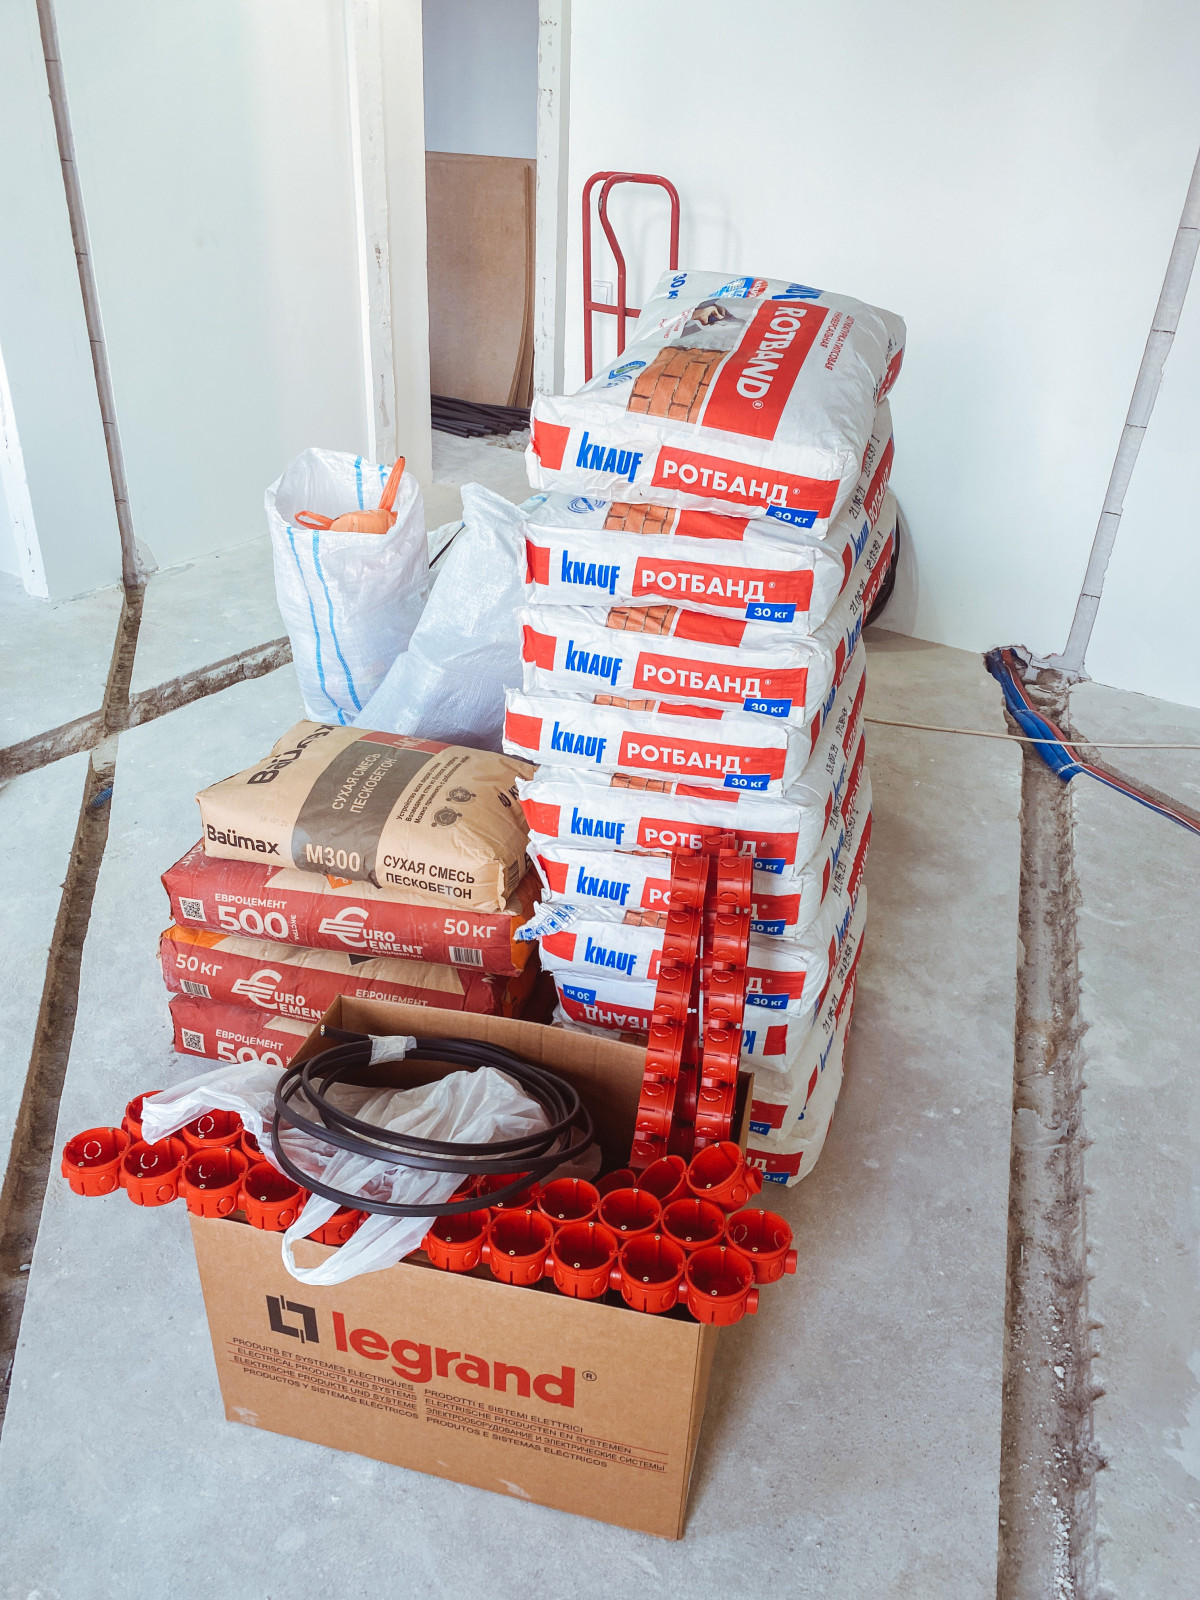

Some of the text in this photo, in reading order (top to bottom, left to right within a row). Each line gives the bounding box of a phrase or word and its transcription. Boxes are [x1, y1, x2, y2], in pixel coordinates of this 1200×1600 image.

[735, 306, 807, 399] ROTBAND
[576, 431, 643, 483] KNAUF
[662, 459, 788, 508] РОТБАНД
[774, 511, 808, 524] 30 кг
[561, 550, 620, 595] KNAUF
[641, 569, 766, 603] РОТБАНД
[754, 607, 788, 619] 30 кг
[565, 640, 622, 686] KNAUF
[643, 664, 762, 699] РОТБАНД
[751, 703, 785, 715] 30 кг
[550, 721, 607, 764] KNAUF
[627, 743, 742, 774] РОТБАНД
[332, 753, 381, 810] СУХАЯ СМЕСЬ
[350, 757, 398, 814] ПЕСКОБЕТОН
[731, 777, 764, 789] 30 кг
[206, 824, 280, 856] Baümax
[571, 807, 625, 845] KNAUF
[645, 828, 758, 858] РОТБД
[306, 843, 361, 873] М300
[383, 855, 475, 884] СУХАЯ СМЕСЬ
[214, 893, 288, 910] ЕВРОЦЕМЕНТ
[385, 872, 472, 900] ПЕСКОБЕТОН
[576, 866, 631, 906] KNAUF
[218, 905, 289, 939] 500
[288, 914, 300, 940] ЭКСТРА
[444, 918, 470, 937] 50
[175, 953, 199, 972] 50
[584, 937, 637, 976] KNAUF
[577, 991, 590, 1001] 30
[753, 998, 783, 1007] 30 кг
[583, 1004, 648, 1030] ТБАНД
[216, 1029, 284, 1051] ЕВРОЦЕМЕНТ
[217, 1040, 284, 1069] 500
[232, 1337, 414, 1391] PRODUITS ET SYSTEMES ELECTRIQUES
[237, 1347, 417, 1400] ELECTRICAL PRODUCTS AND SYSTEMS
[332, 1311, 575, 1408] legrand
[234, 1355, 417, 1410] ELEKTRISCHE PRODUKTE UND SYSTEME
[243, 1367, 300, 1387] PRODUCTOS
[311, 1385, 357, 1402] SISTEMAS
[424, 1388, 476, 1407] PRODOTTI
[487, 1404, 528, 1420] SISTEMI
[531, 1415, 583, 1433] ELETTRICI
[425, 1398, 632, 1454] ELEKTRISCHE PRODUCTEN EN SYSTEMEN
[426, 1416, 481, 1436] PRODUTOS
[492, 1433, 541, 1450] SISTEMAS
[426, 1407, 533, 1439] ЭЛЕКТРООБОРУДОВАНИЕ
[544, 1437, 617, 1460] ЭЛЕКТРИЧЕСКИЕ
[619, 1455, 665, 1471] СИСТЕМЫ
